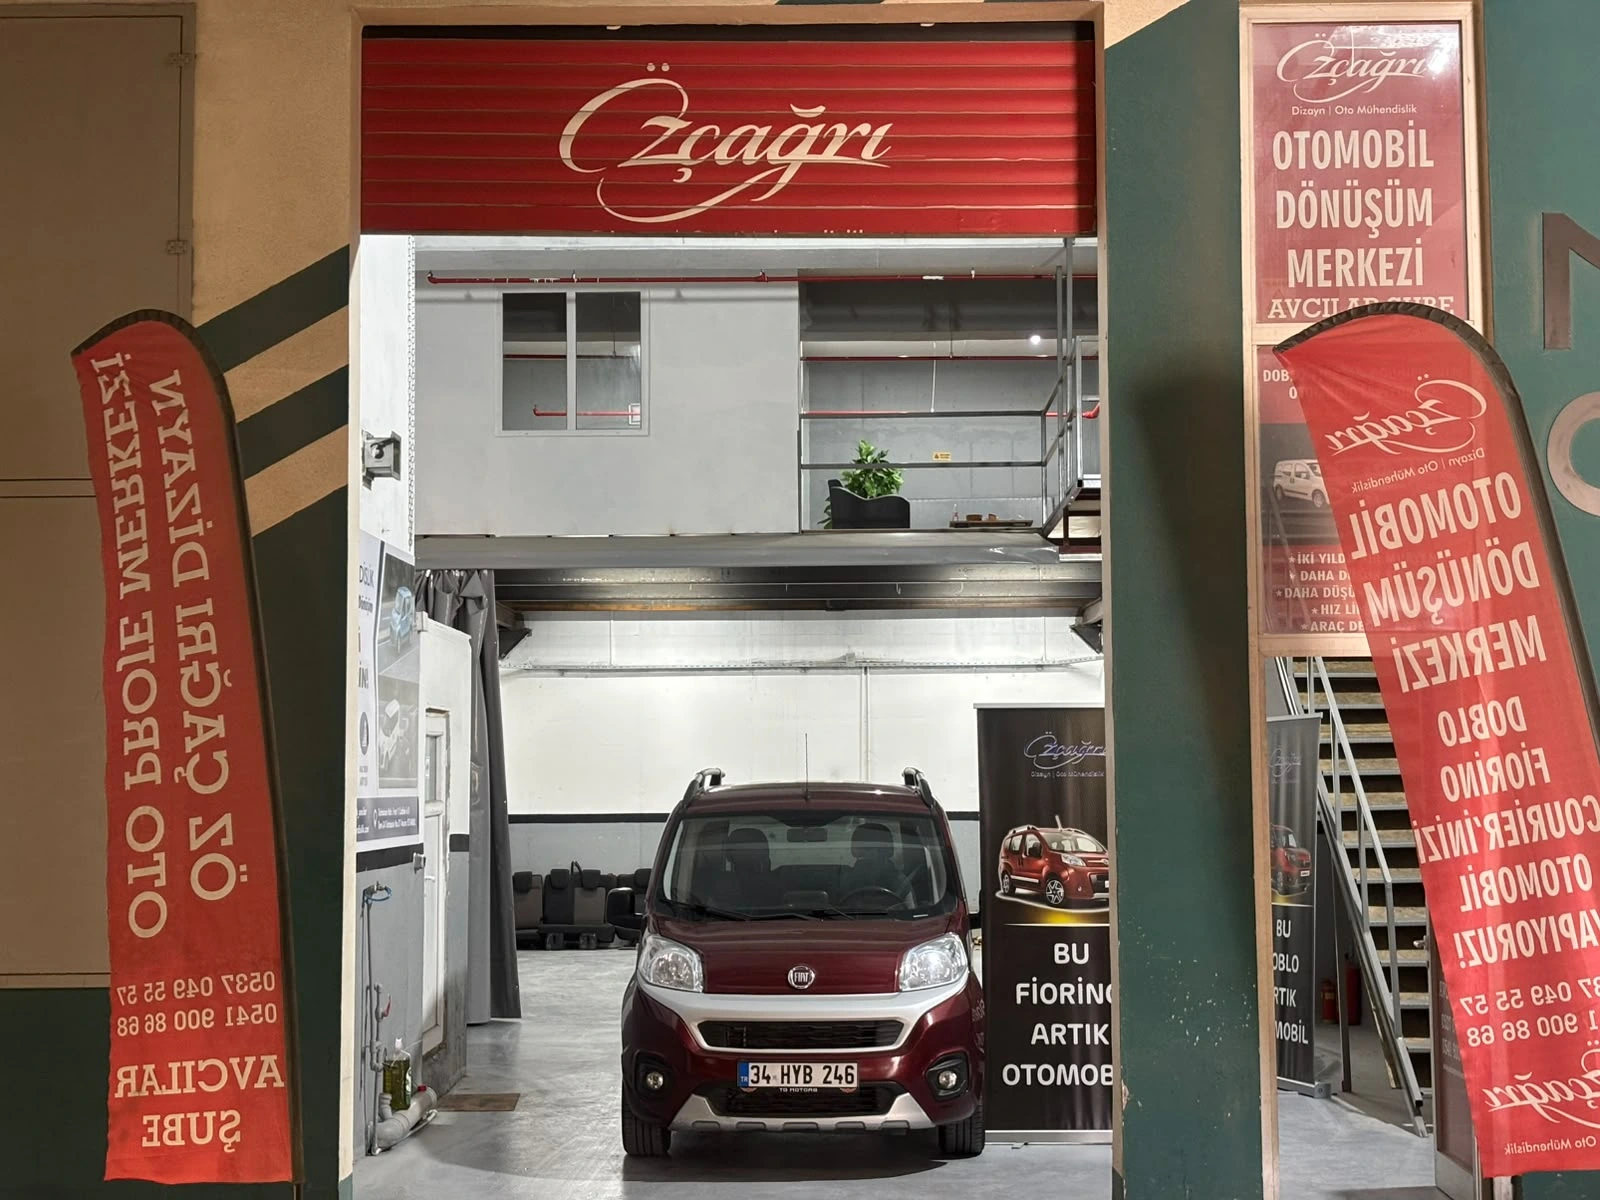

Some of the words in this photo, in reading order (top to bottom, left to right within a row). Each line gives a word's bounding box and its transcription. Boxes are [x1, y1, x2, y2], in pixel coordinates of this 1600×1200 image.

[1291, 106, 1326, 117] Dizayn
[1334, 106, 1355, 115] Oto
[1357, 104, 1418, 115] Mühendislik
[558, 62, 893, 224] Özçağrı
[1272, 119, 1435, 171] OTOMOBİL
[1275, 178, 1433, 239] DÖNÜŞÜM
[1287, 238, 1424, 288] MERKEZİ
[1263, 369, 1293, 382] DOB
[1297, 552, 1315, 564] İKİ
[1300, 570, 1335, 581] DAHA
[1284, 587, 1319, 598] DAHA
[1320, 604, 1341, 615] HIZ
[1310, 621, 1345, 633] ARAÇ
[1276, 919, 1291, 938] BU
[1053, 942, 1090, 965] BU
[794, 972, 809, 982] FIAT
[1030, 1023, 1110, 1045] ARTIK
[750, 1065, 771, 1085] 34
[780, 1065, 813, 1085] HYB
[822, 1065, 855, 1085] 246
